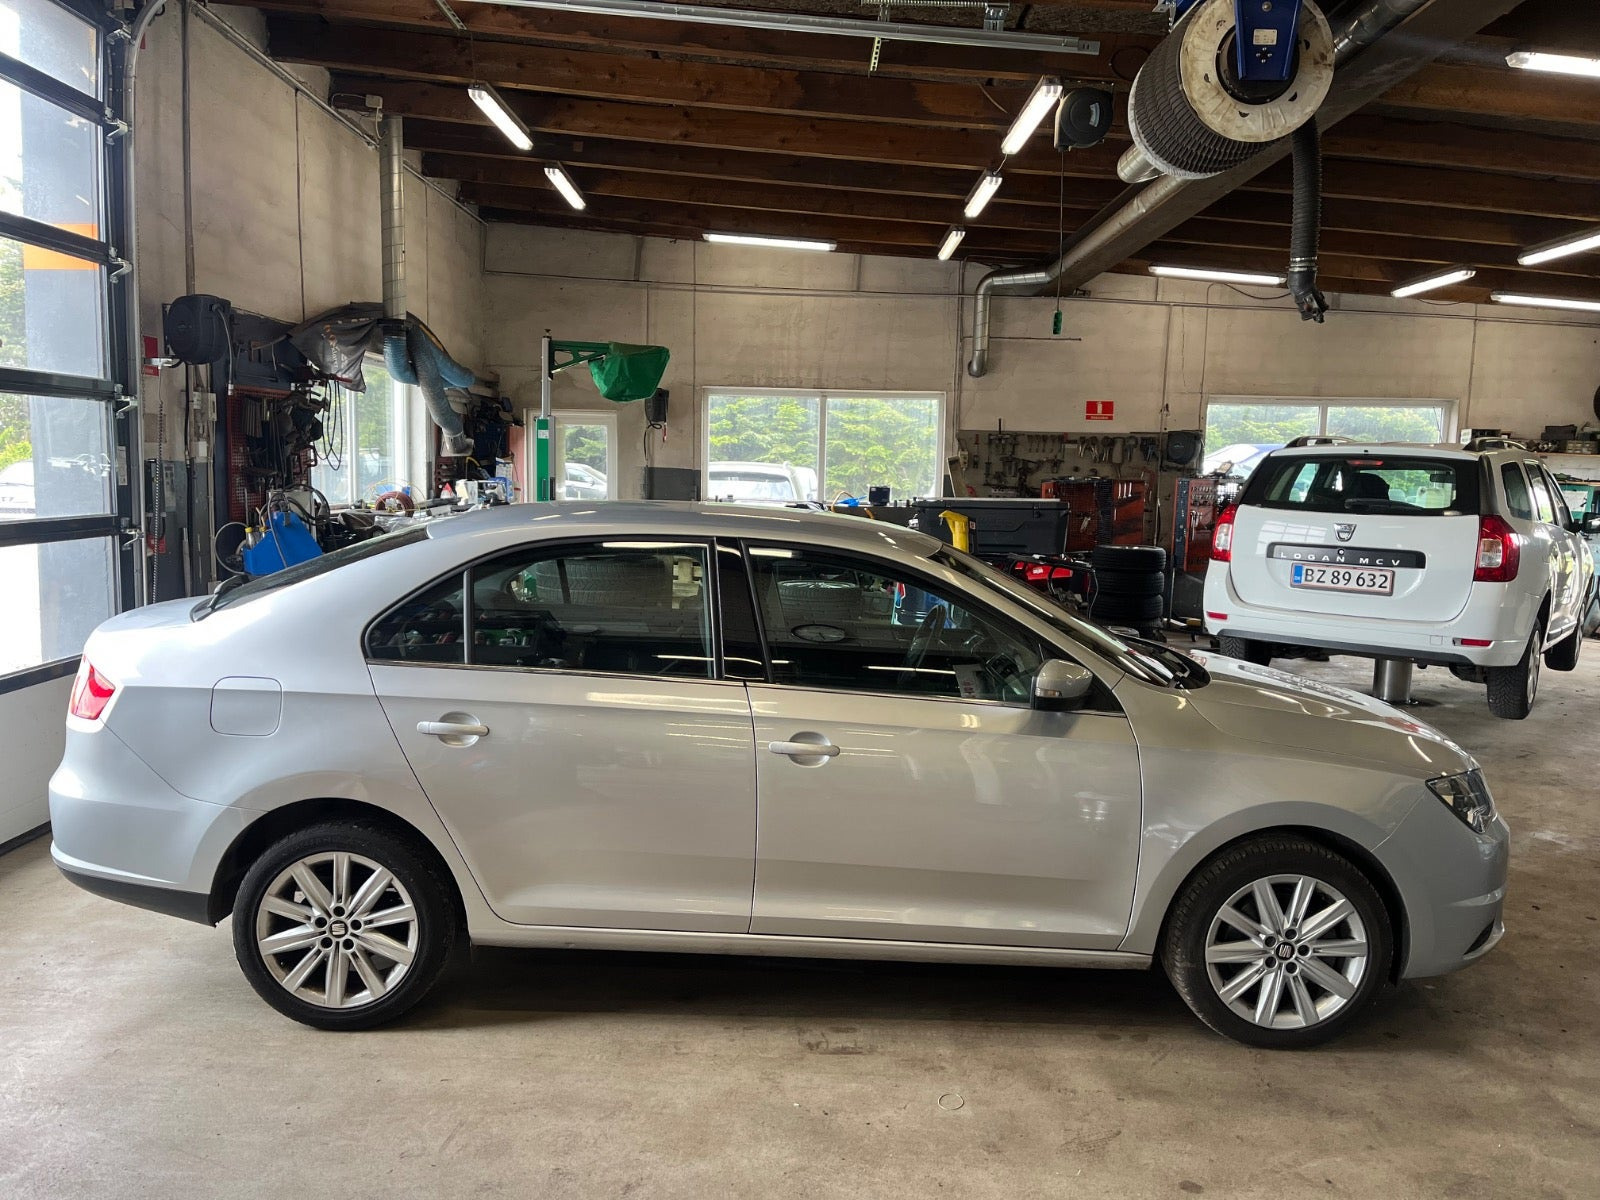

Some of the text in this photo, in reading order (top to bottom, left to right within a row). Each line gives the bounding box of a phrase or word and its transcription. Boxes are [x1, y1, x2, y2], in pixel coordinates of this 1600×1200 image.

[1281, 552, 1400, 566] LOGAN MCV
[1304, 568, 1388, 589] BZ 89 632
